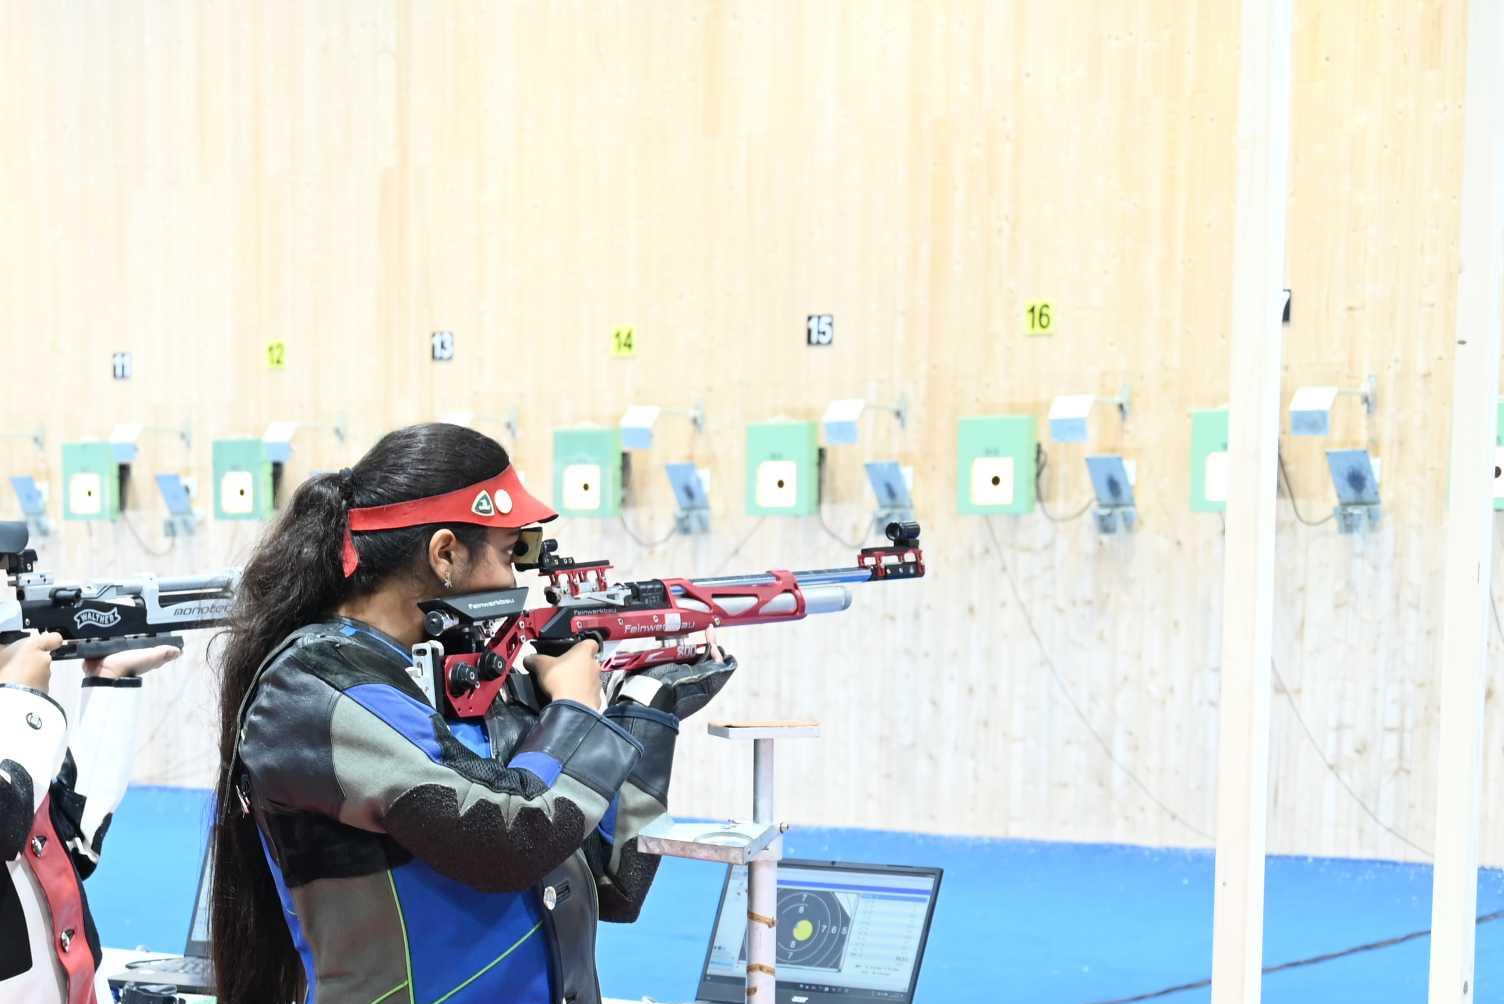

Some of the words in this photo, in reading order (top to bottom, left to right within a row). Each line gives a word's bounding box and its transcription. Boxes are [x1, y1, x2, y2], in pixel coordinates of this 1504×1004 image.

[1027, 303, 1051, 330] 16
[614, 330, 633, 352] 14
[807, 315, 833, 345] 15
[268, 343, 284, 365] 12
[432, 331, 454, 360] 13
[80, 611, 115, 625] WALTHER
